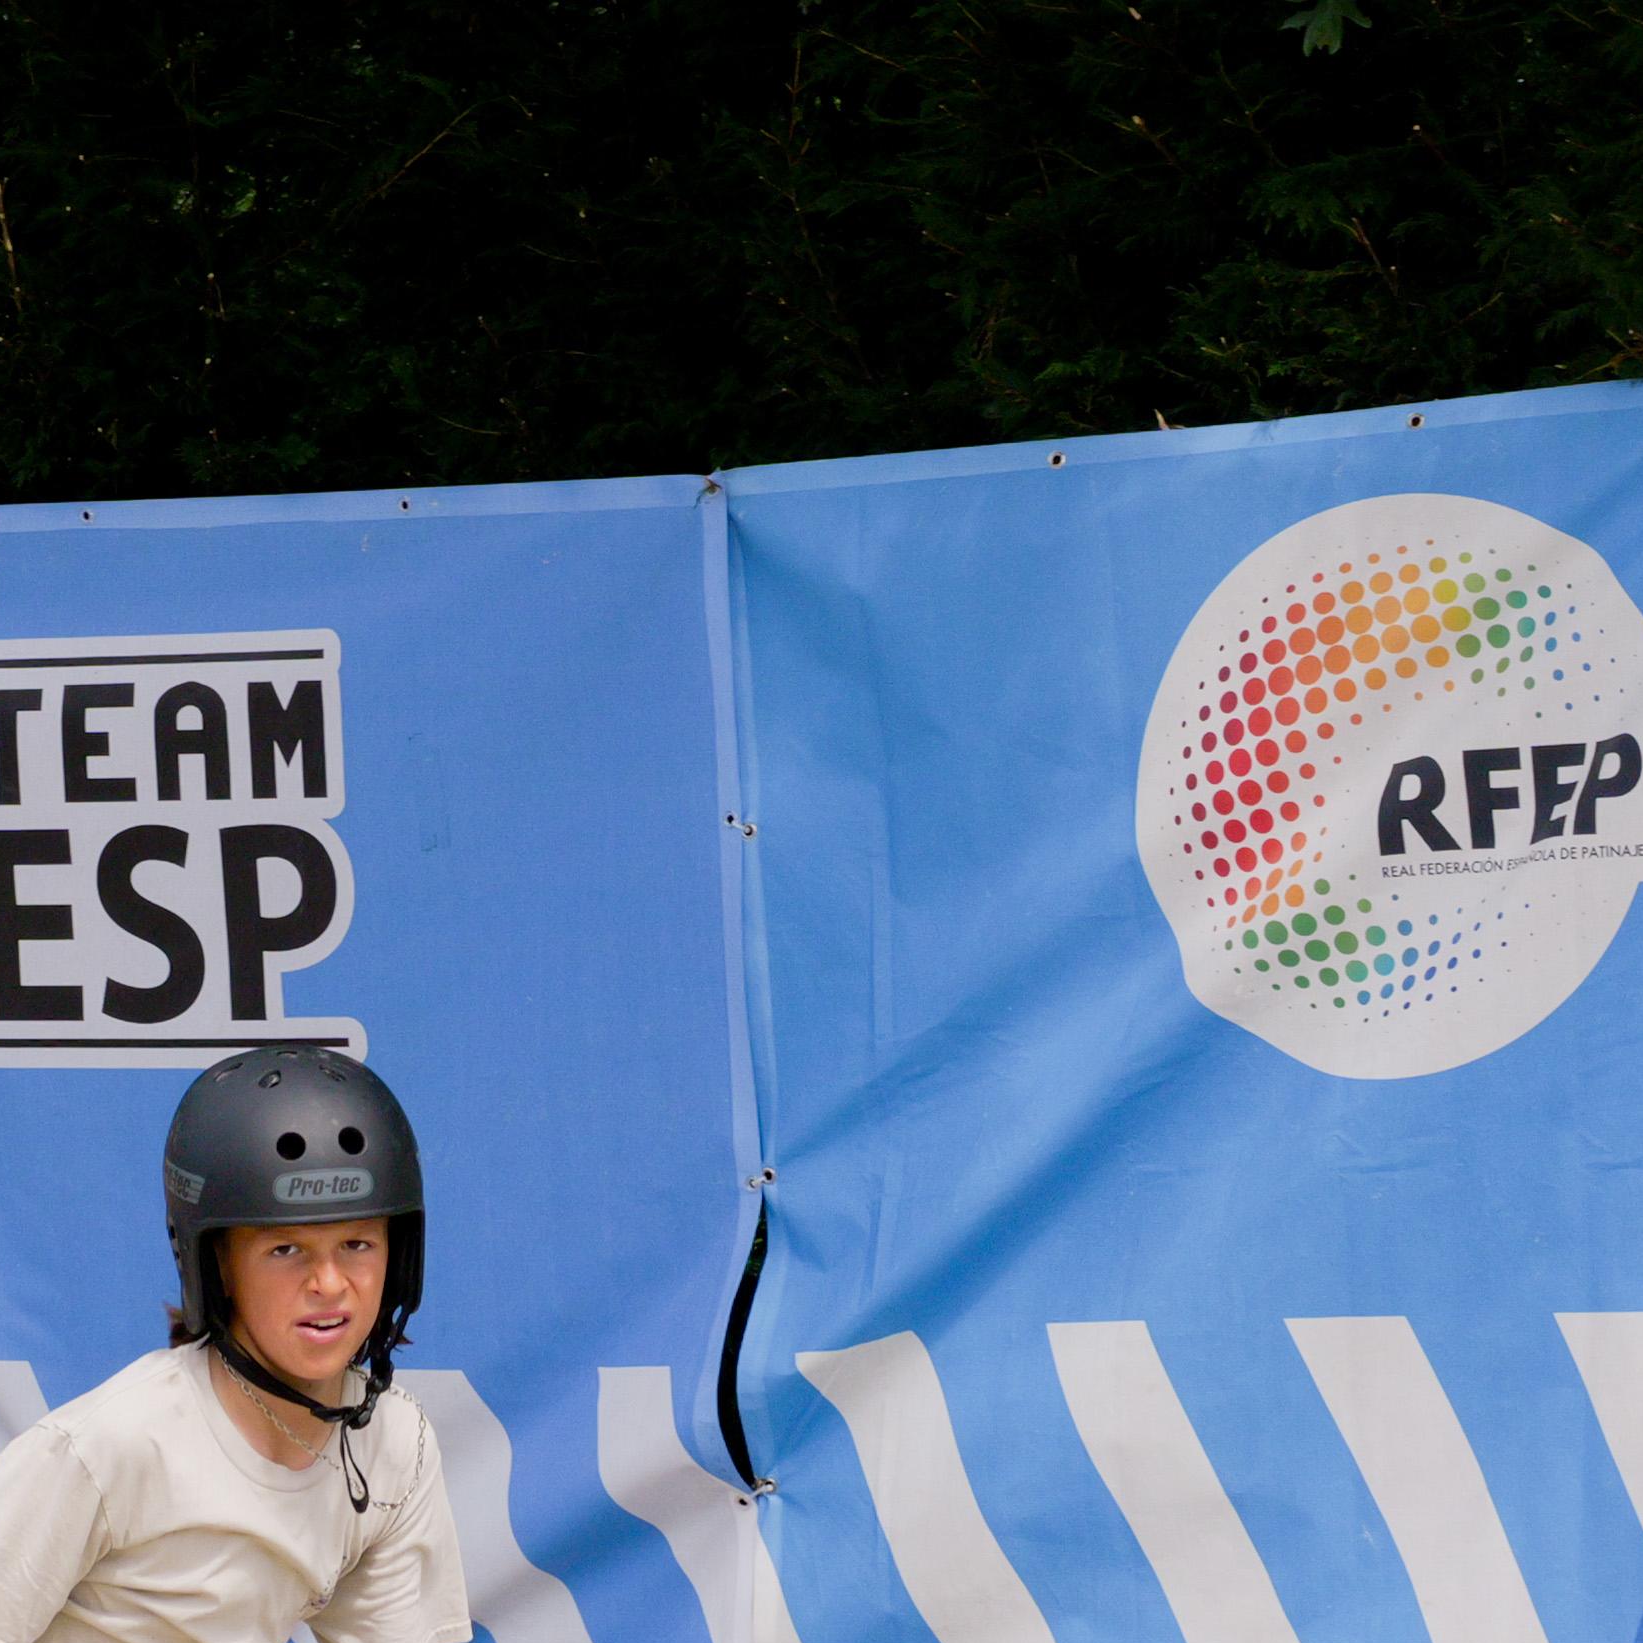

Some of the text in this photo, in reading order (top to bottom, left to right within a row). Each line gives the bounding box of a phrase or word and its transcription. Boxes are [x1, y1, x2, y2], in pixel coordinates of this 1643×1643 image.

[1378, 733, 1642, 856] RFEP
[1381, 864, 1416, 878] REAL
[1420, 856, 1503, 876] FEDERACIÓN
[1560, 846, 1578, 860] DE
[287, 1175, 361, 1198] Pro-tec
